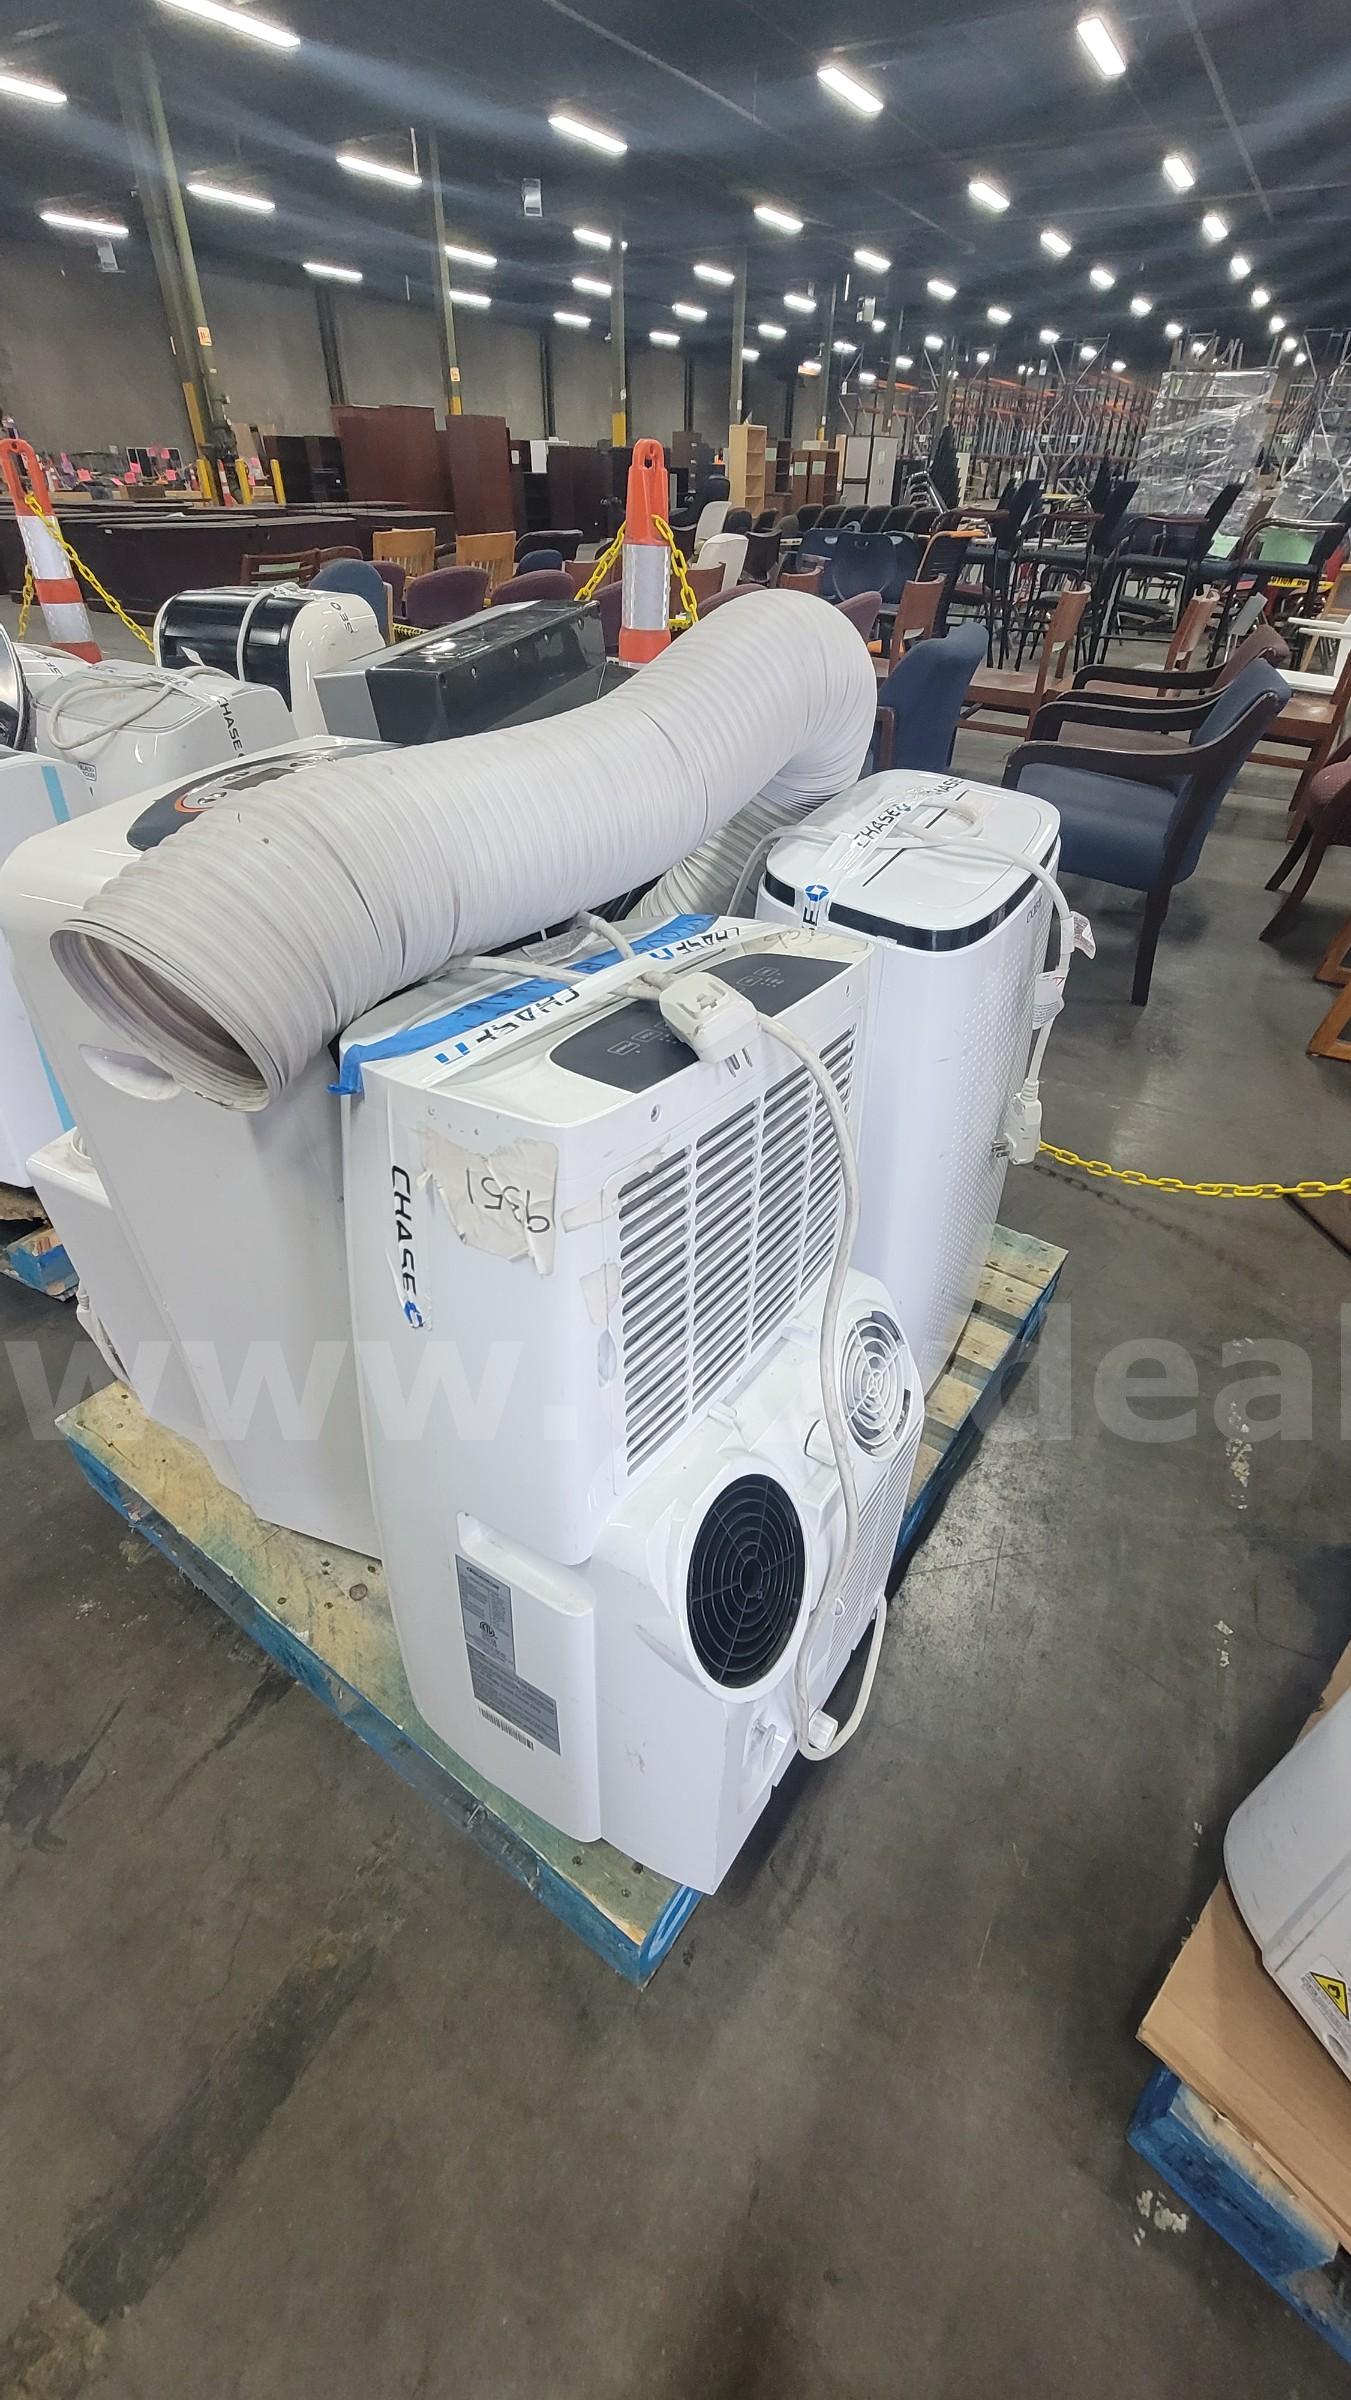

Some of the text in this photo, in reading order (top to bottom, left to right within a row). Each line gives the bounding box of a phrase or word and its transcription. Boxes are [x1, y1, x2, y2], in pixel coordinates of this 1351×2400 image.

[926, 777, 964, 795] HASE
[854, 802, 902, 849] CHASE
[391, 1164, 417, 1297] CHASE
